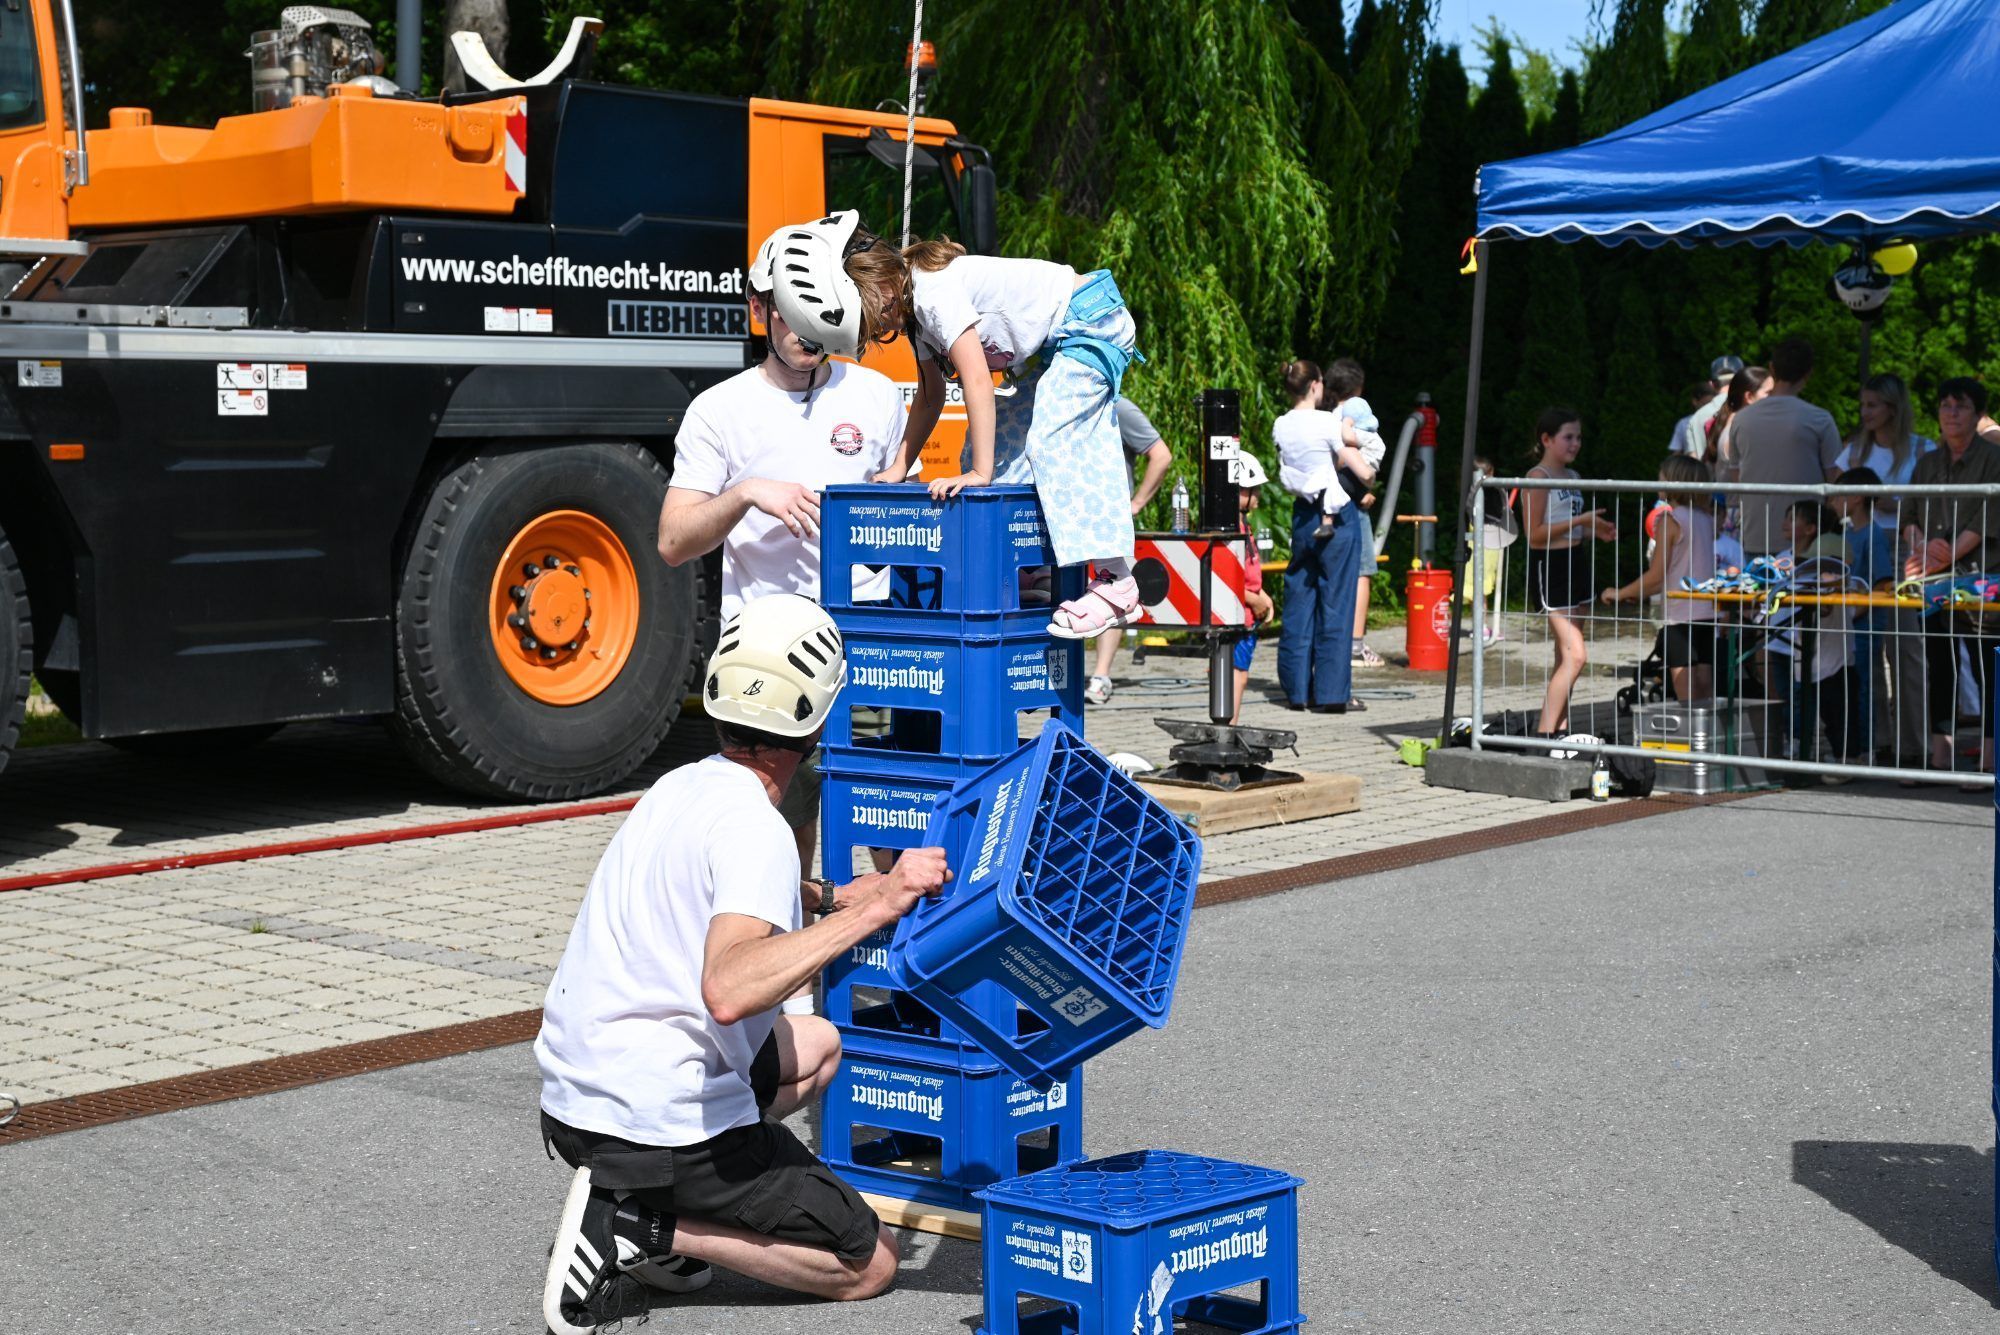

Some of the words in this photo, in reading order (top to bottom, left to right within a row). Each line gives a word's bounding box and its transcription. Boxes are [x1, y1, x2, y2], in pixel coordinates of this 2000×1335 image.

[401, 254, 743, 295] www.scheffknecht-kran.at
[610, 303, 747, 335] LIEBHERR
[848, 506, 888, 519] Münchens
[888, 507, 920, 519] Brauerei
[850, 524, 943, 552] Augustiner
[851, 647, 890, 660] Münchens
[891, 648, 921, 662] Brauerei
[852, 666, 945, 695] Augustiner
[851, 787, 890, 800] Münchens
[890, 790, 921, 804] Brauerei
[921, 793, 937, 801] teste
[852, 805, 932, 831] ugustiner
[969, 778, 1014, 884] Augustiner
[852, 946, 887, 971] tiner
[850, 1066, 889, 1082] Münchens
[890, 1072, 921, 1087] Brauerei
[851, 1085, 944, 1121] Augustiner
[1211, 1211, 1246, 1233] Brauerei
[1246, 1206, 1268, 1220] älteste
[1169, 1220, 1212, 1241] Münchens
[1171, 1224, 1269, 1275] Augustiner
[1010, 1254, 1059, 1276] Augustiner-
